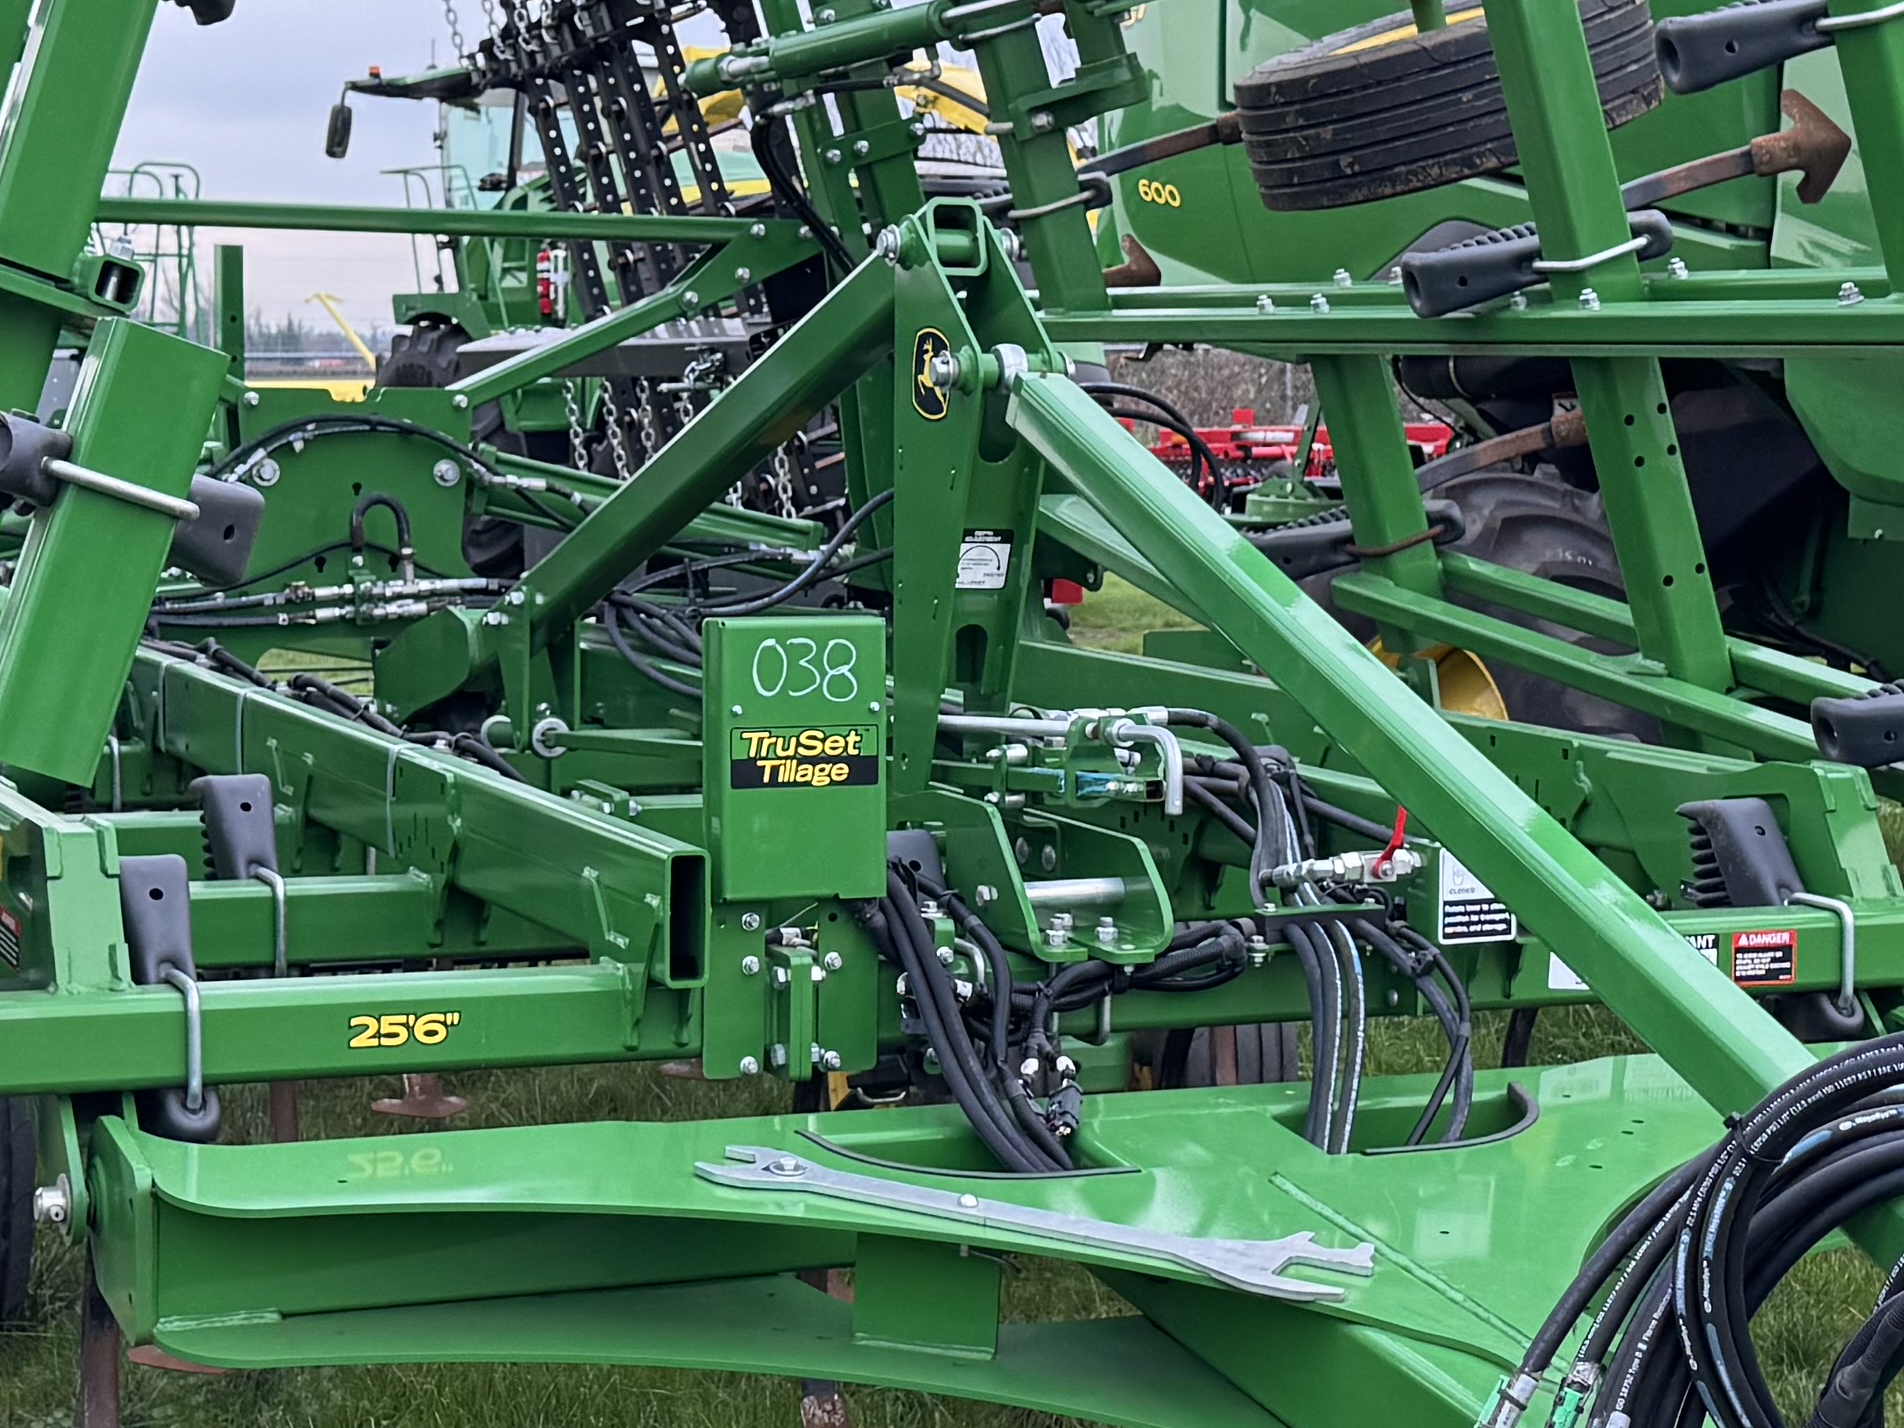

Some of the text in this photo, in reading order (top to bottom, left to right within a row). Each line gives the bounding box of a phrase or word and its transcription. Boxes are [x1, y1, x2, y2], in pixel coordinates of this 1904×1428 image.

[1138, 179, 1181, 208] 600
[752, 638, 858, 702] 038
[756, 759, 850, 786] Tillage
[1749, 932, 1790, 946] DANGER
[349, 1012, 460, 1048] 25'6"
